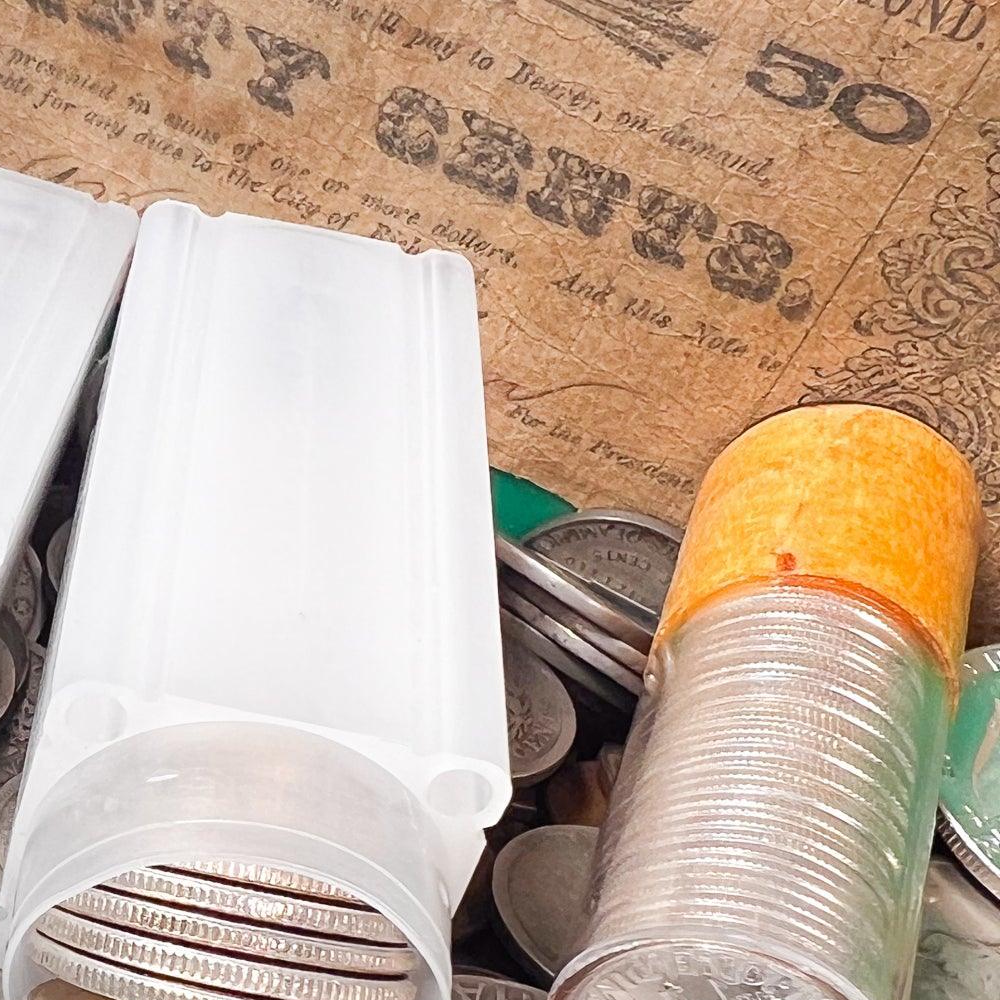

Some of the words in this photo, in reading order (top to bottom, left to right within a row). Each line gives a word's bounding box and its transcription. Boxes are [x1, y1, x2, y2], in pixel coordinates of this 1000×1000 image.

[402, 26, 463, 62] pay
[468, 47, 494, 71] to
[615, 111, 650, 133] on
[745, 39, 932, 145] 50
[32, 88, 77, 110] for
[83, 109, 129, 140] any
[190, 151, 214, 173] to
[227, 167, 267, 194] the
[326, 211, 360, 232] of
[126, 92, 150, 116] in
[232, 140, 265, 163] of
[270, 156, 312, 178] one
[321, 177, 351, 194] or
[360, 193, 422, 226] more
[551, 271, 617, 305] And
